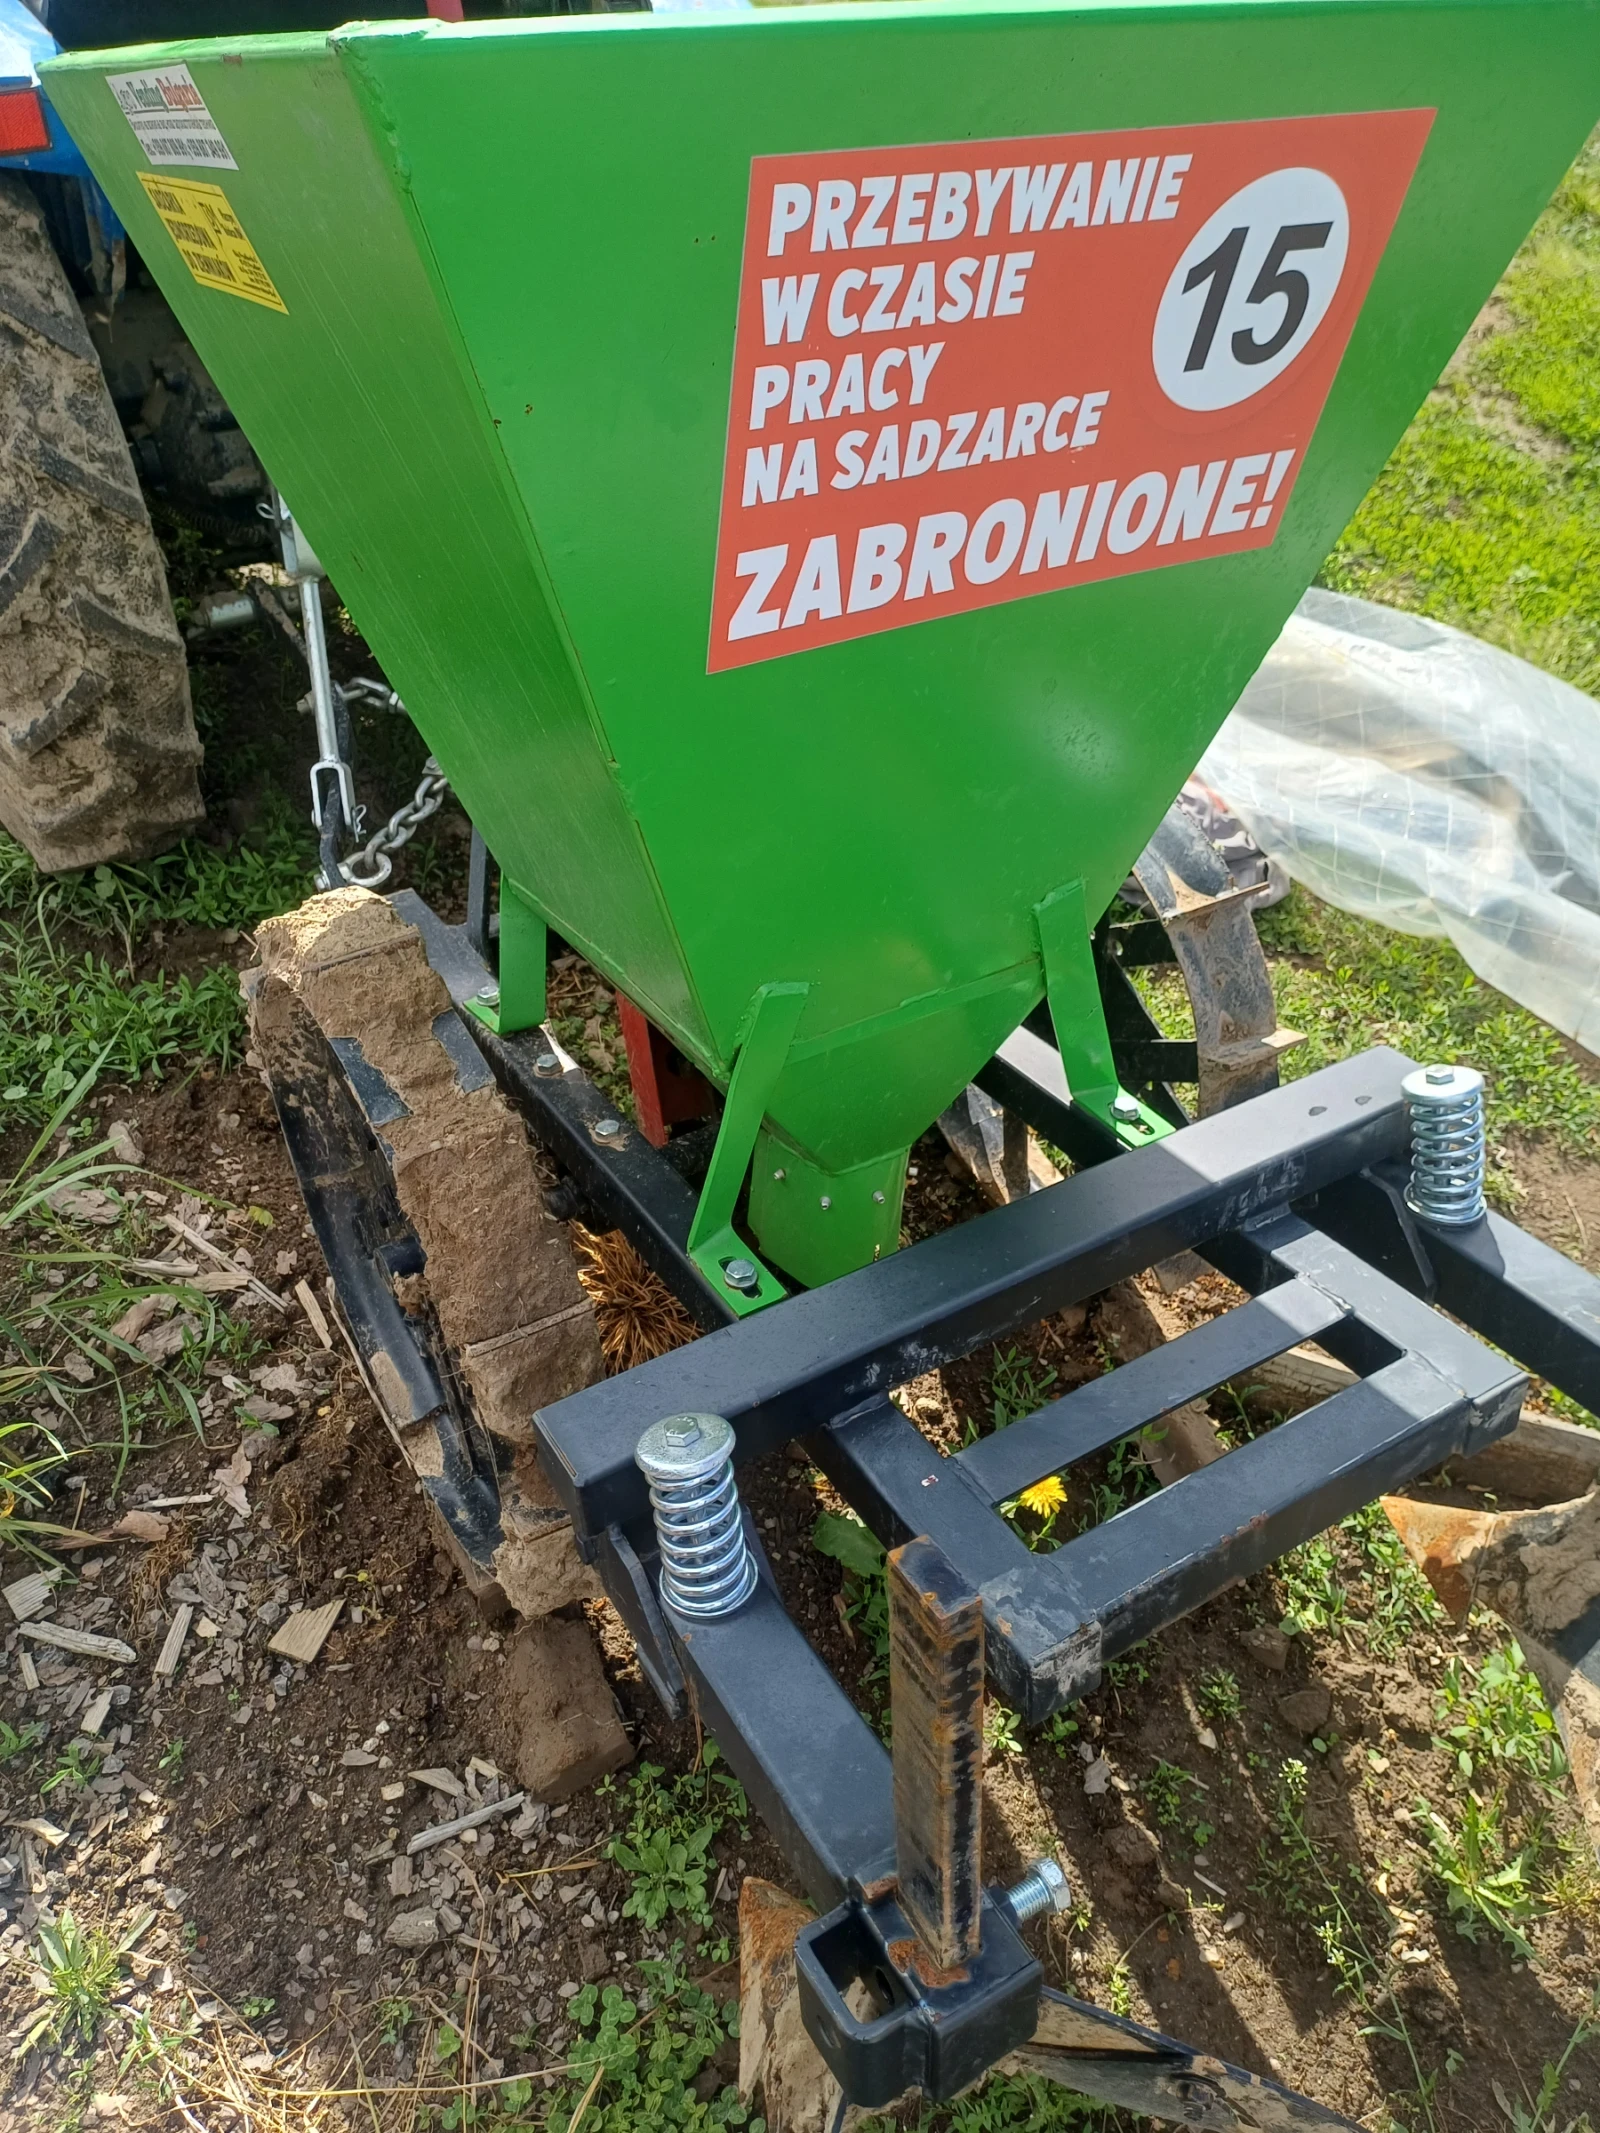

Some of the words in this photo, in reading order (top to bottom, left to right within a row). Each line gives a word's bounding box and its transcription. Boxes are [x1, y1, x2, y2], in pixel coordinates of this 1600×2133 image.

[766, 153, 1194, 257] PRZEBYWANIE
[761, 274, 818, 346] W
[827, 251, 1035, 338] CZASIE
[1181, 221, 1335, 374] 15
[748, 341, 946, 431] PRACY
[741, 437, 819, 508] NA
[831, 391, 1110, 491] SADZARCE
[727, 449, 1296, 642] ZABRONIONE!
